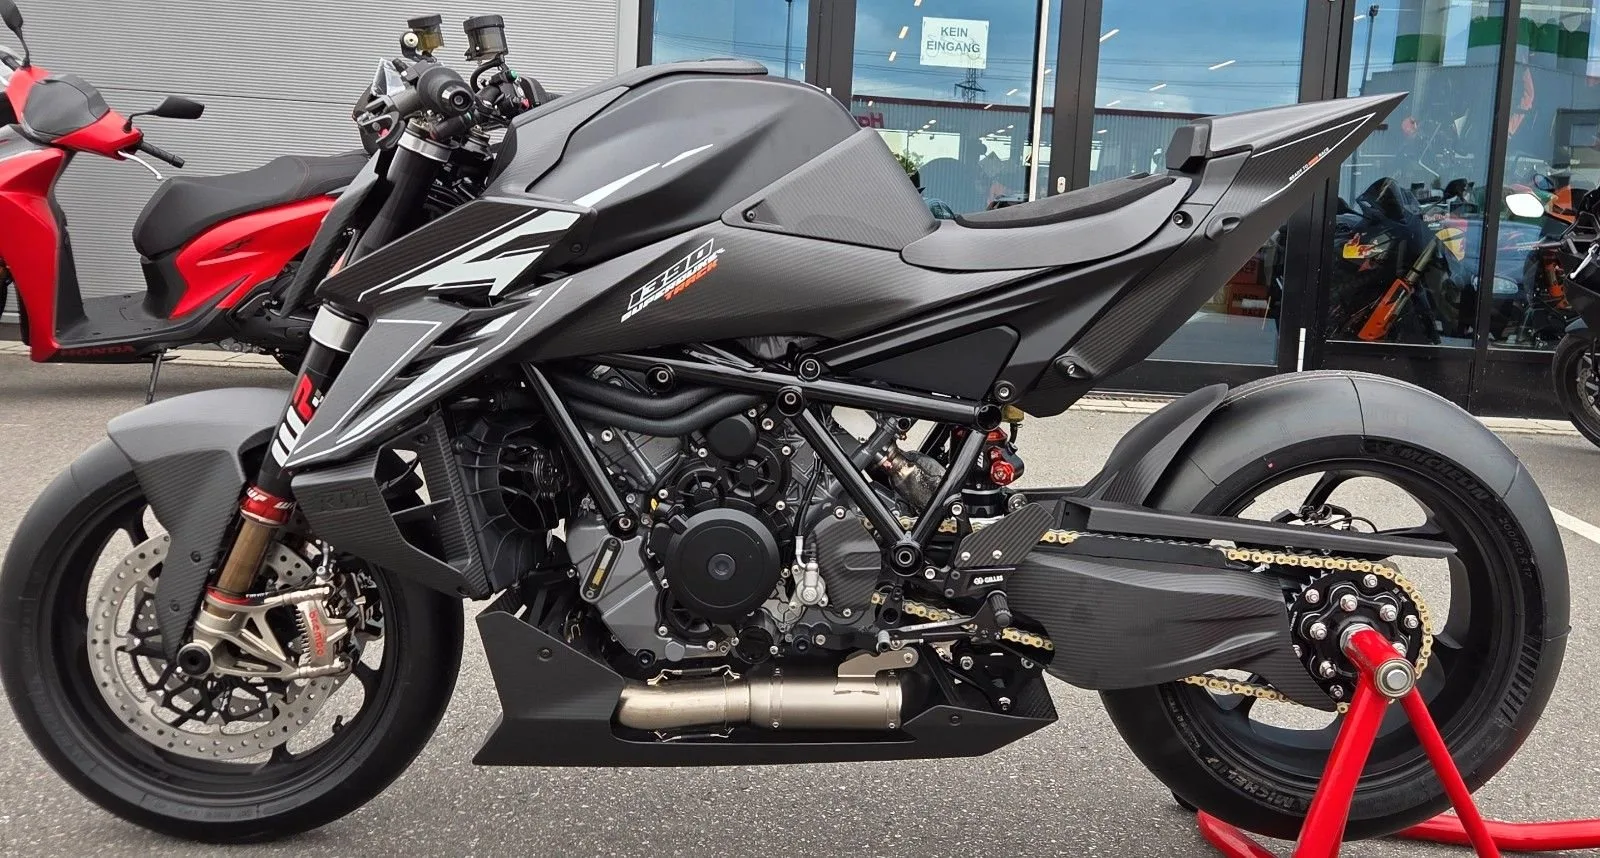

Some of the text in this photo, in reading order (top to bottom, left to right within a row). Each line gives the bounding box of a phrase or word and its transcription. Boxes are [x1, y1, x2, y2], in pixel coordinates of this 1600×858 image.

[940, 27, 968, 37] KEIN
[926, 40, 981, 53] EINGANG
[627, 238, 714, 311] 1390
[664, 258, 719, 301] TRACK
[60, 344, 136, 357] HONDA
[1399, 447, 1493, 501] MICHELIN
[984, 575, 1004, 583] GILLES
[309, 608, 327, 657] brembo
